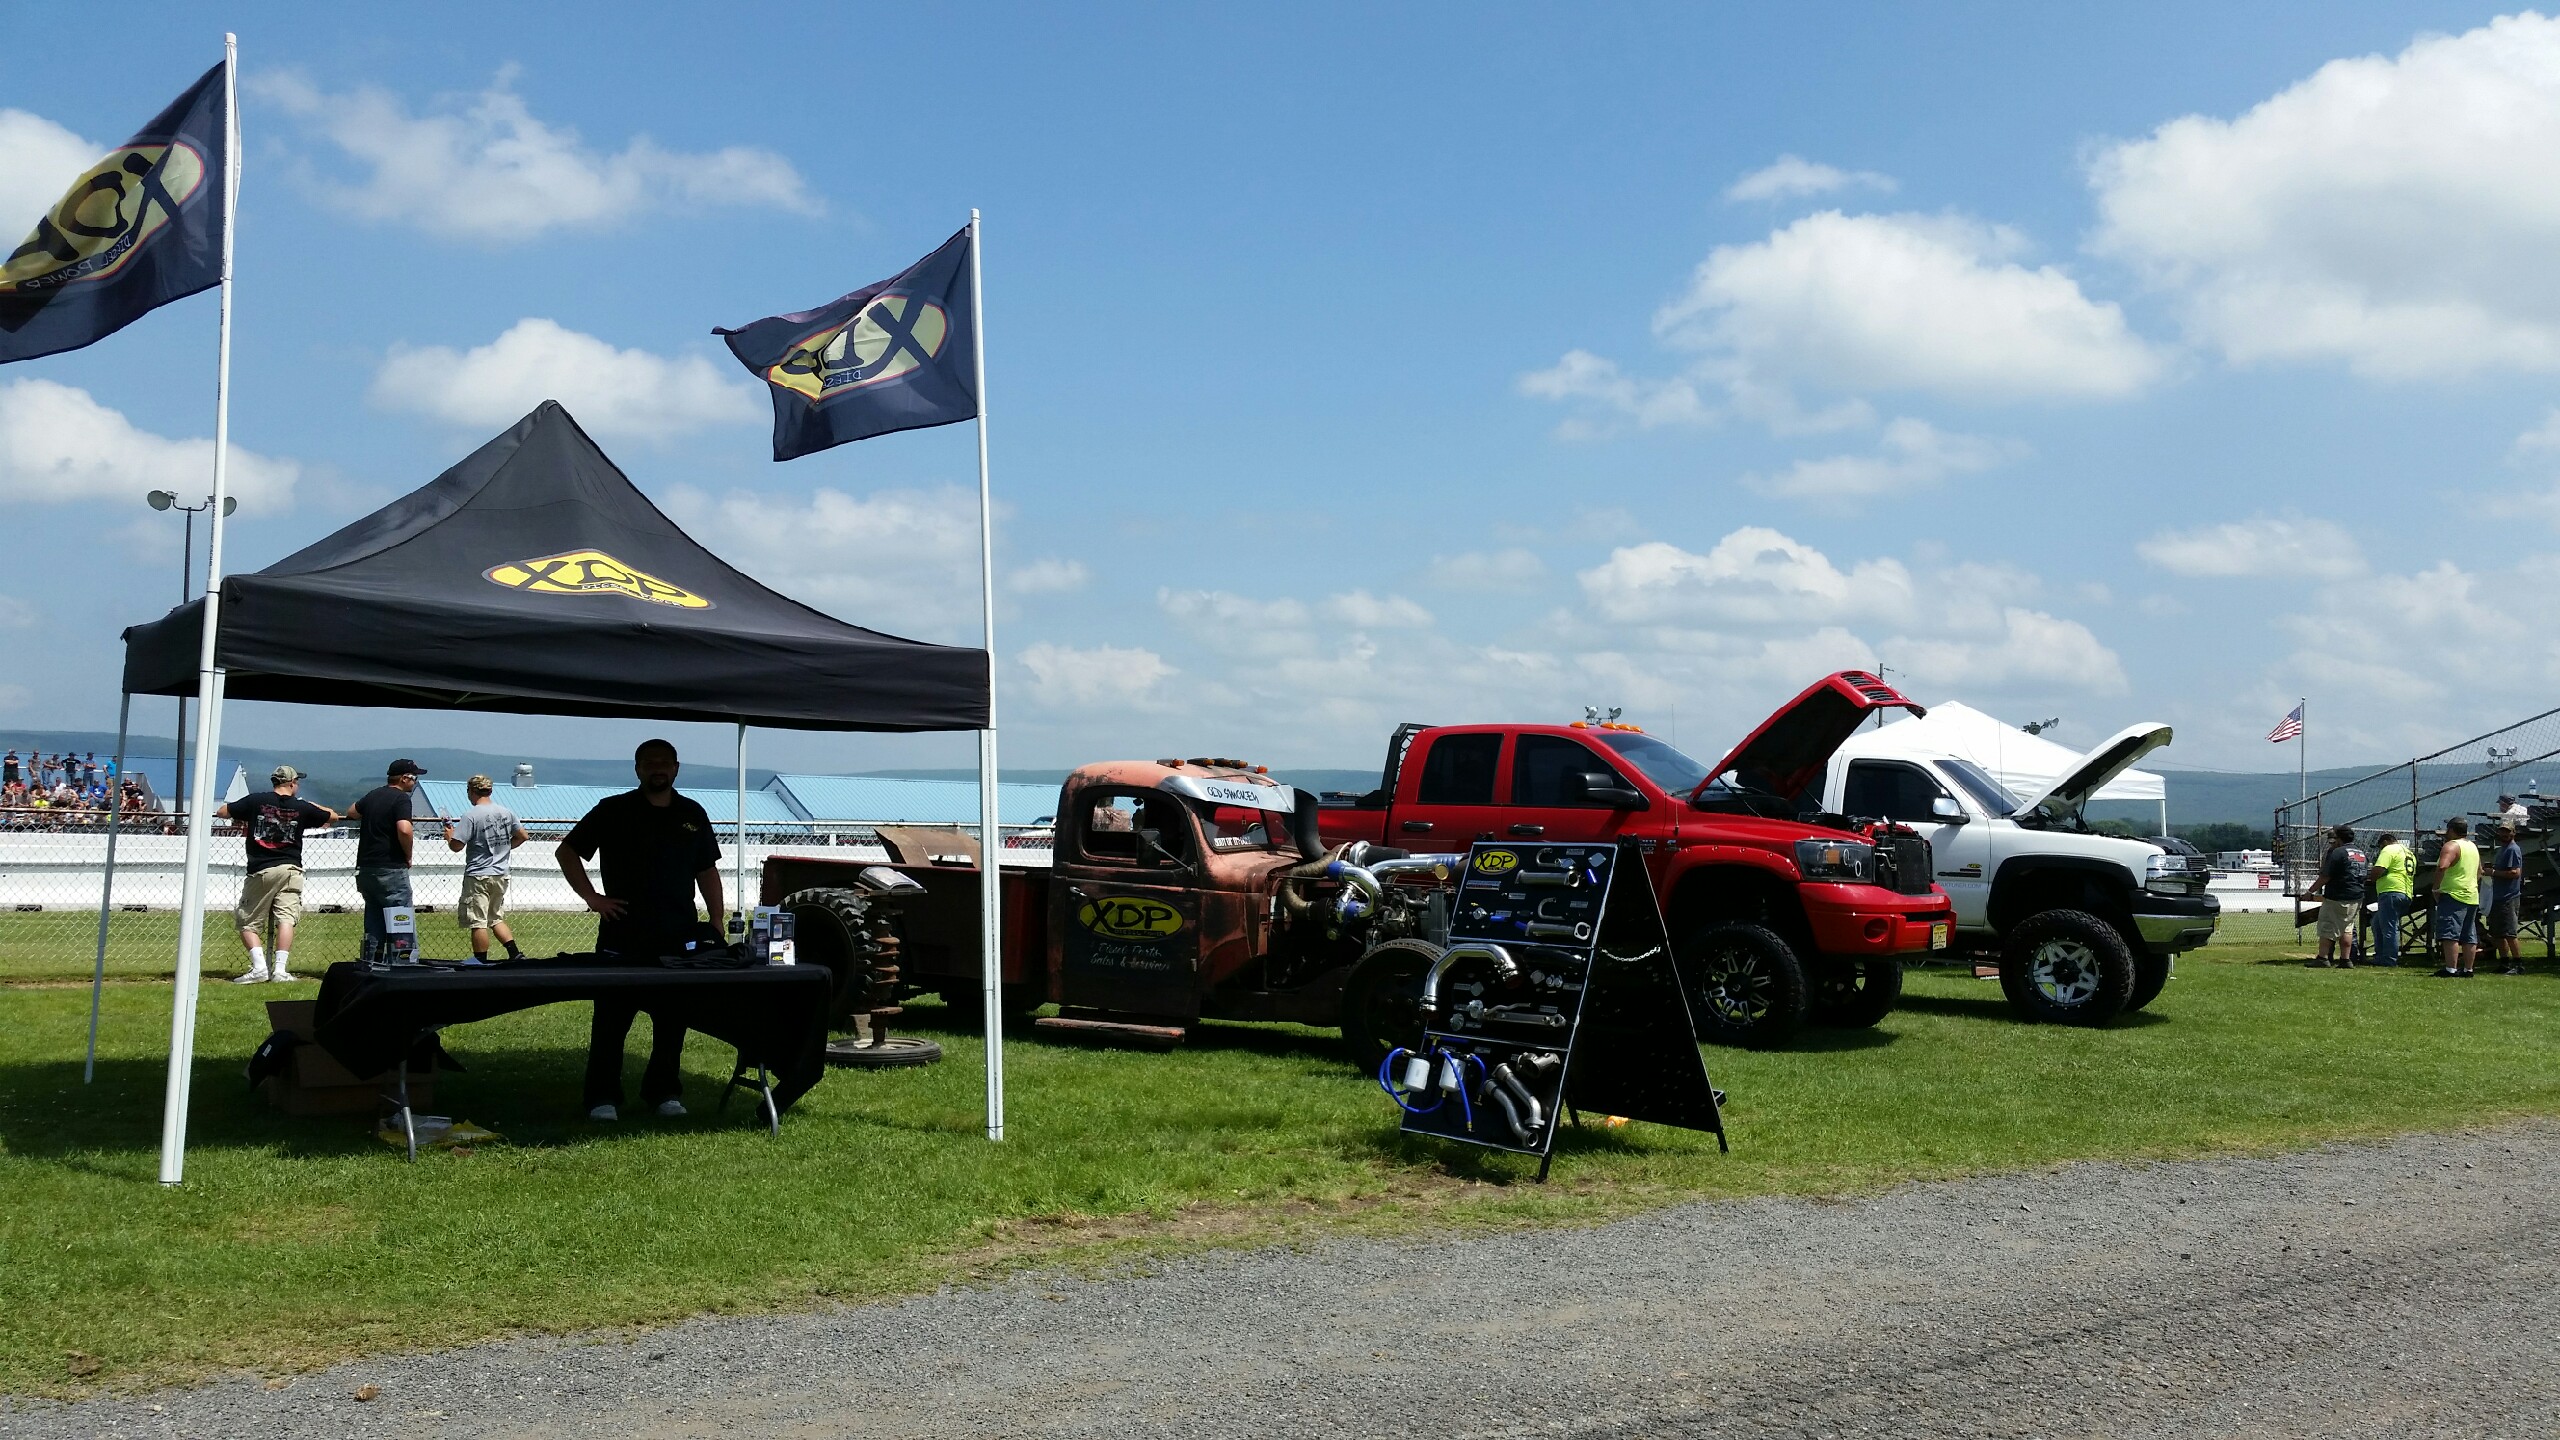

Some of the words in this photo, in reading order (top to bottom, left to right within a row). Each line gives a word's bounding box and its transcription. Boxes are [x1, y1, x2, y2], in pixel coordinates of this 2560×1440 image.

[507, 560, 688, 598] XDP
[1206, 786, 1223, 799] OLD
[1475, 852, 1515, 870] XDP
[1089, 899, 1174, 933] XDP
